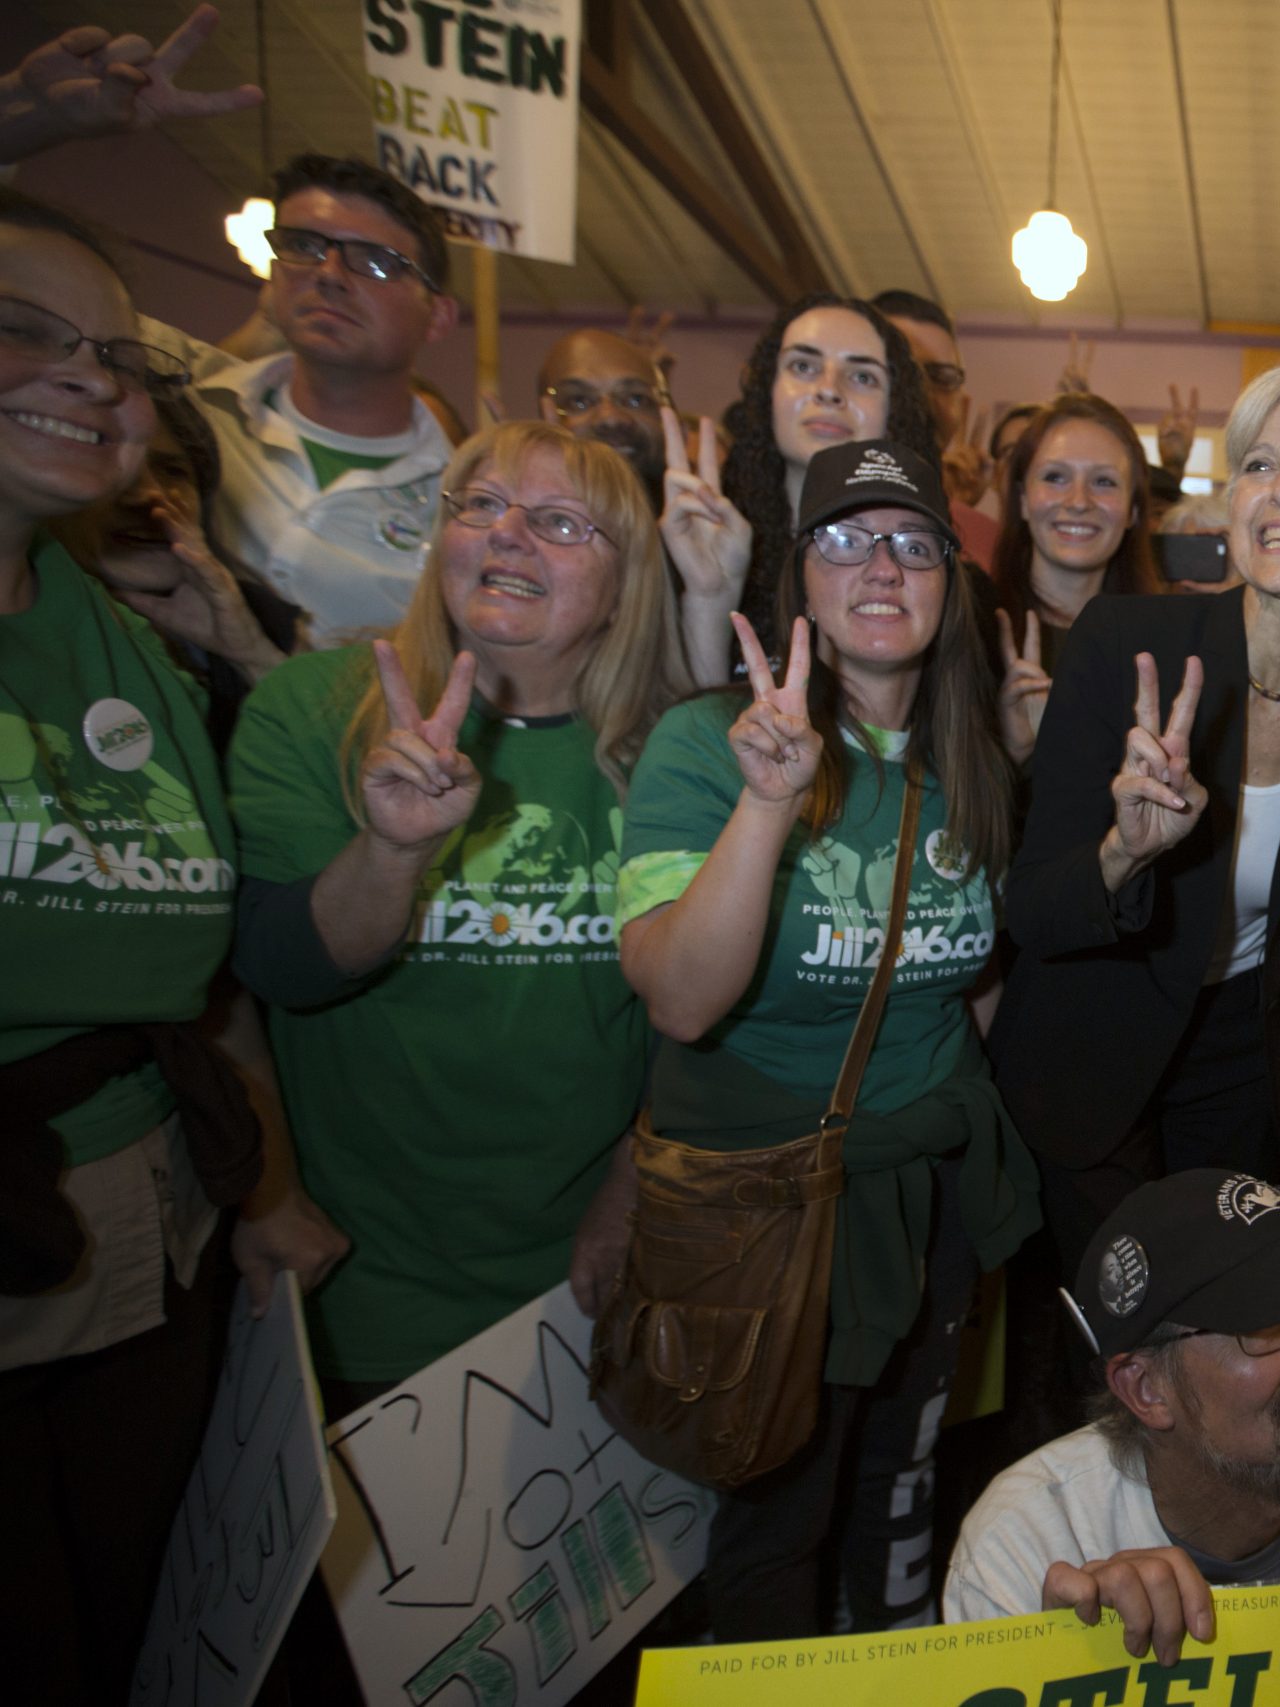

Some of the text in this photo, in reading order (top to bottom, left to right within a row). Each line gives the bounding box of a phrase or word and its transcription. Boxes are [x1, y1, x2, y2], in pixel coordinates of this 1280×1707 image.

[366, 0, 566, 97] STEIN
[369, 75, 499, 151] BEAT
[530, 882, 573, 894] PEACE
[36, 895, 85, 911] JILL
[95, 900, 151, 914] STEIN
[920, 907, 957, 920] PEACE
[800, 922, 994, 968] Jill2016.co
[457, 952, 490, 966] JILL
[495, 953, 539, 966] STEIN
[545, 952, 573, 964] FOR
[796, 970, 836, 985] VOTE
[896, 970, 934, 983] STEIN
[937, 966, 959, 977] FOR
[700, 1622, 1056, 1676] PAID FOR BY JILL STEIN FOR PRESIDENT
